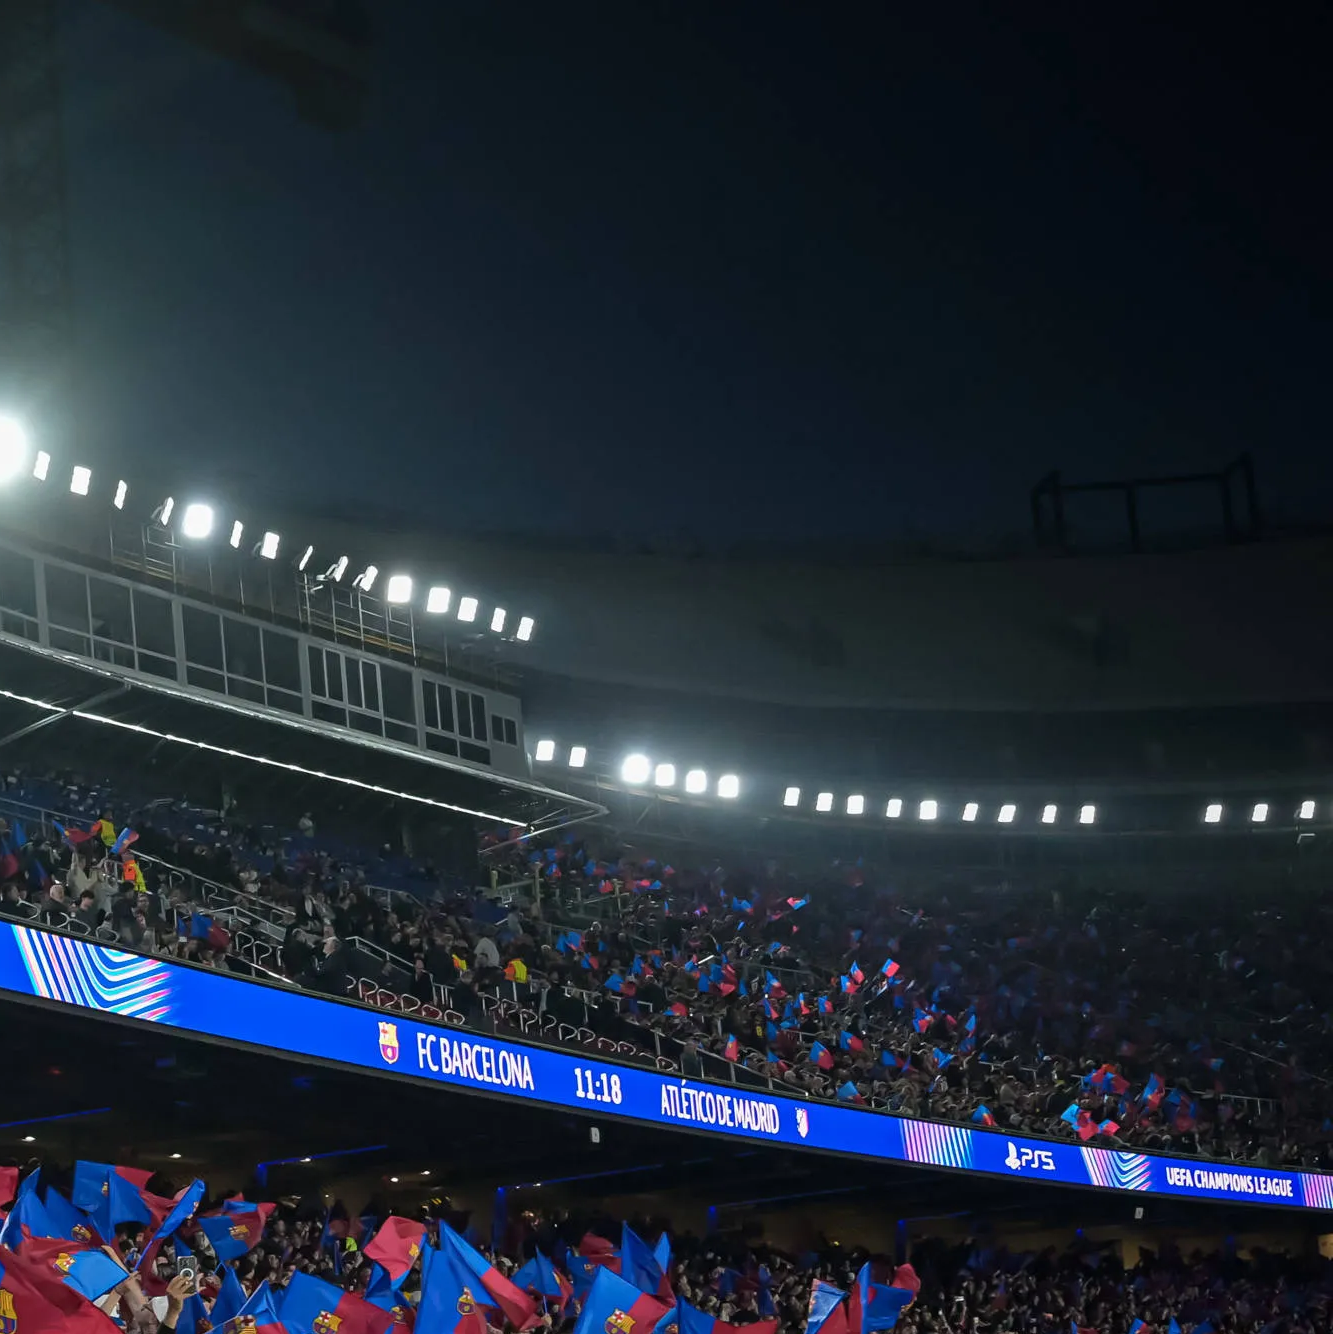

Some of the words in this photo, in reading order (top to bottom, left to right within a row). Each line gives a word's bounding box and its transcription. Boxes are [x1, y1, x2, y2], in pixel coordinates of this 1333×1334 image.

[416, 1032, 440, 1072] FC
[440, 1037, 535, 1091] BARCELONA
[574, 1067, 623, 1105] 11:18
[661, 1078, 717, 1125] ATLÉTICO
[716, 1094, 735, 1127] DE
[734, 1097, 780, 1135] MADRID
[1021, 1147, 1056, 1171] PS5
[1165, 1166, 1194, 1187] UEFA
[1194, 1169, 1254, 1194] CHAMPIONS
[1254, 1176, 1294, 1197] LEAGUE
